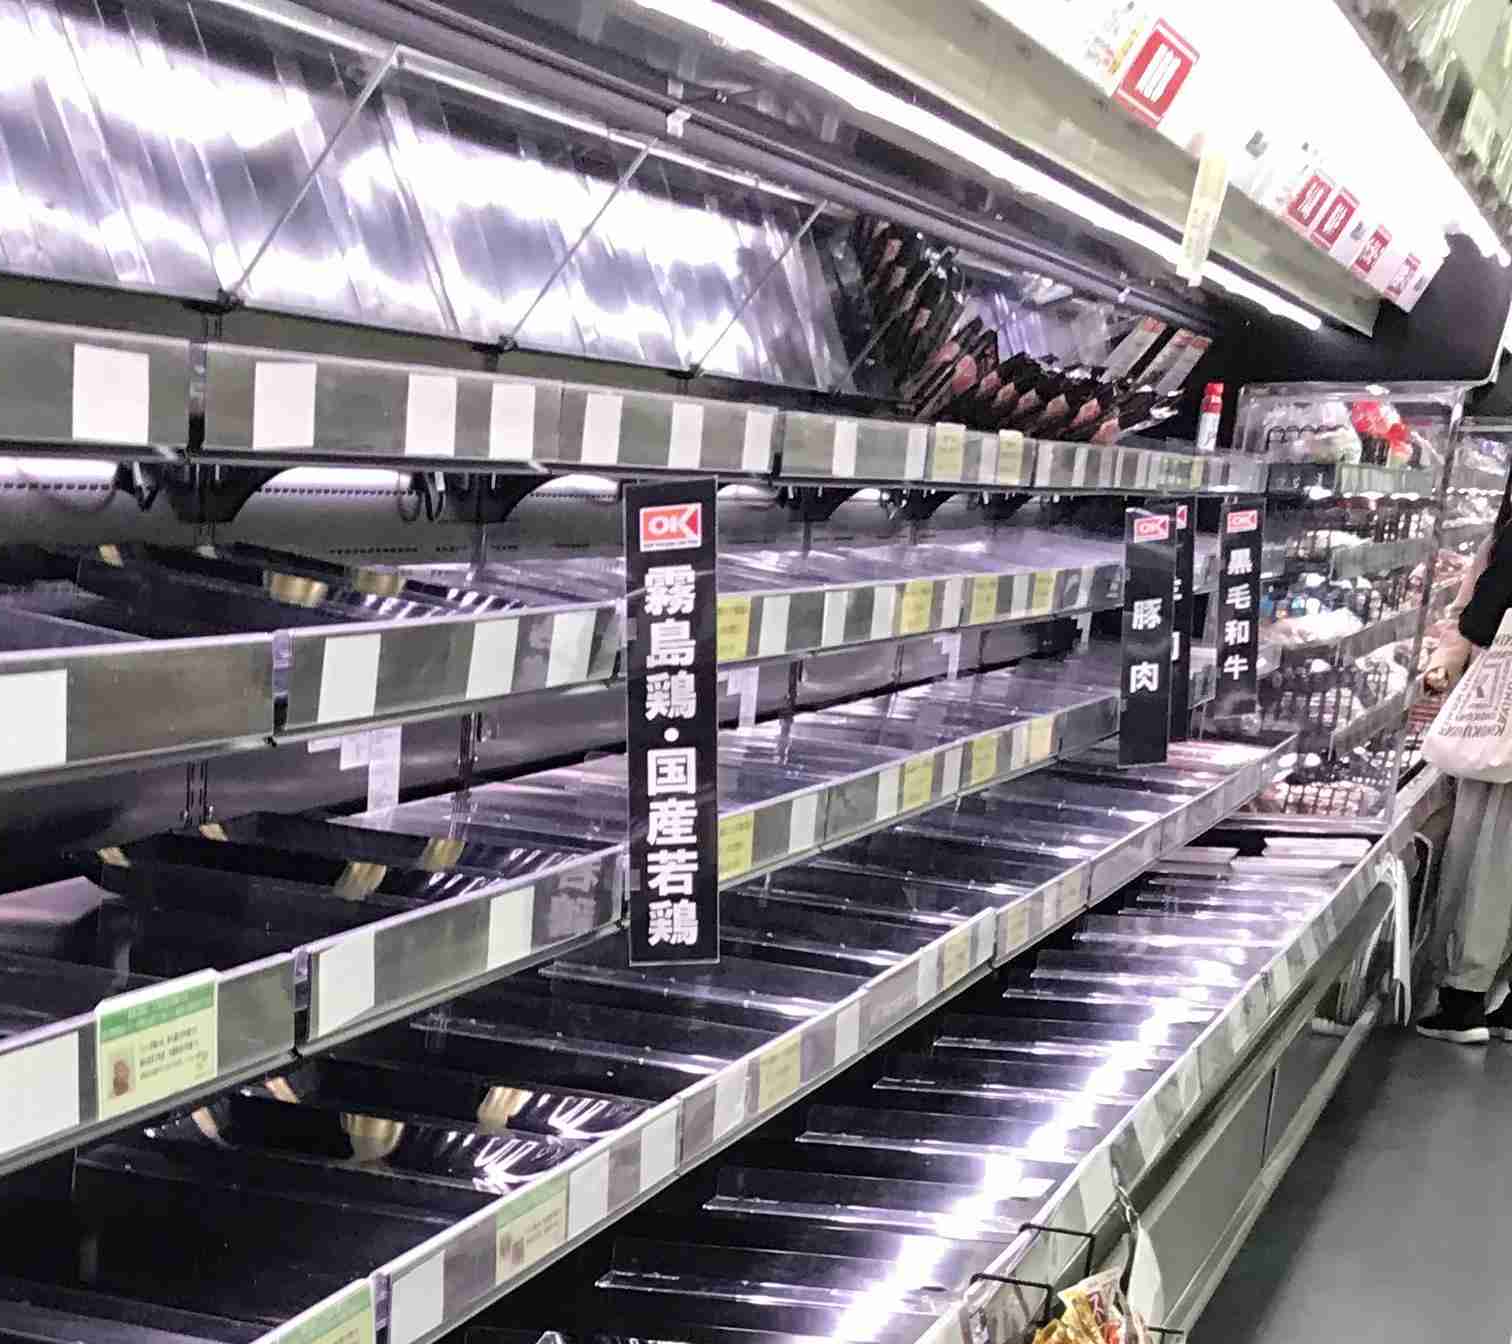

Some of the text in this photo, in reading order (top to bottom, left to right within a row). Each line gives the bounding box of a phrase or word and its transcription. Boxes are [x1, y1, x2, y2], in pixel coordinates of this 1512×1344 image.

[647, 505, 697, 538] OK
[1129, 598, 1163, 694] 豚肉
[1223, 548, 1253, 681] 黒毛和牛
[644, 563, 700, 948] 霧島鶏・国産若鶏
